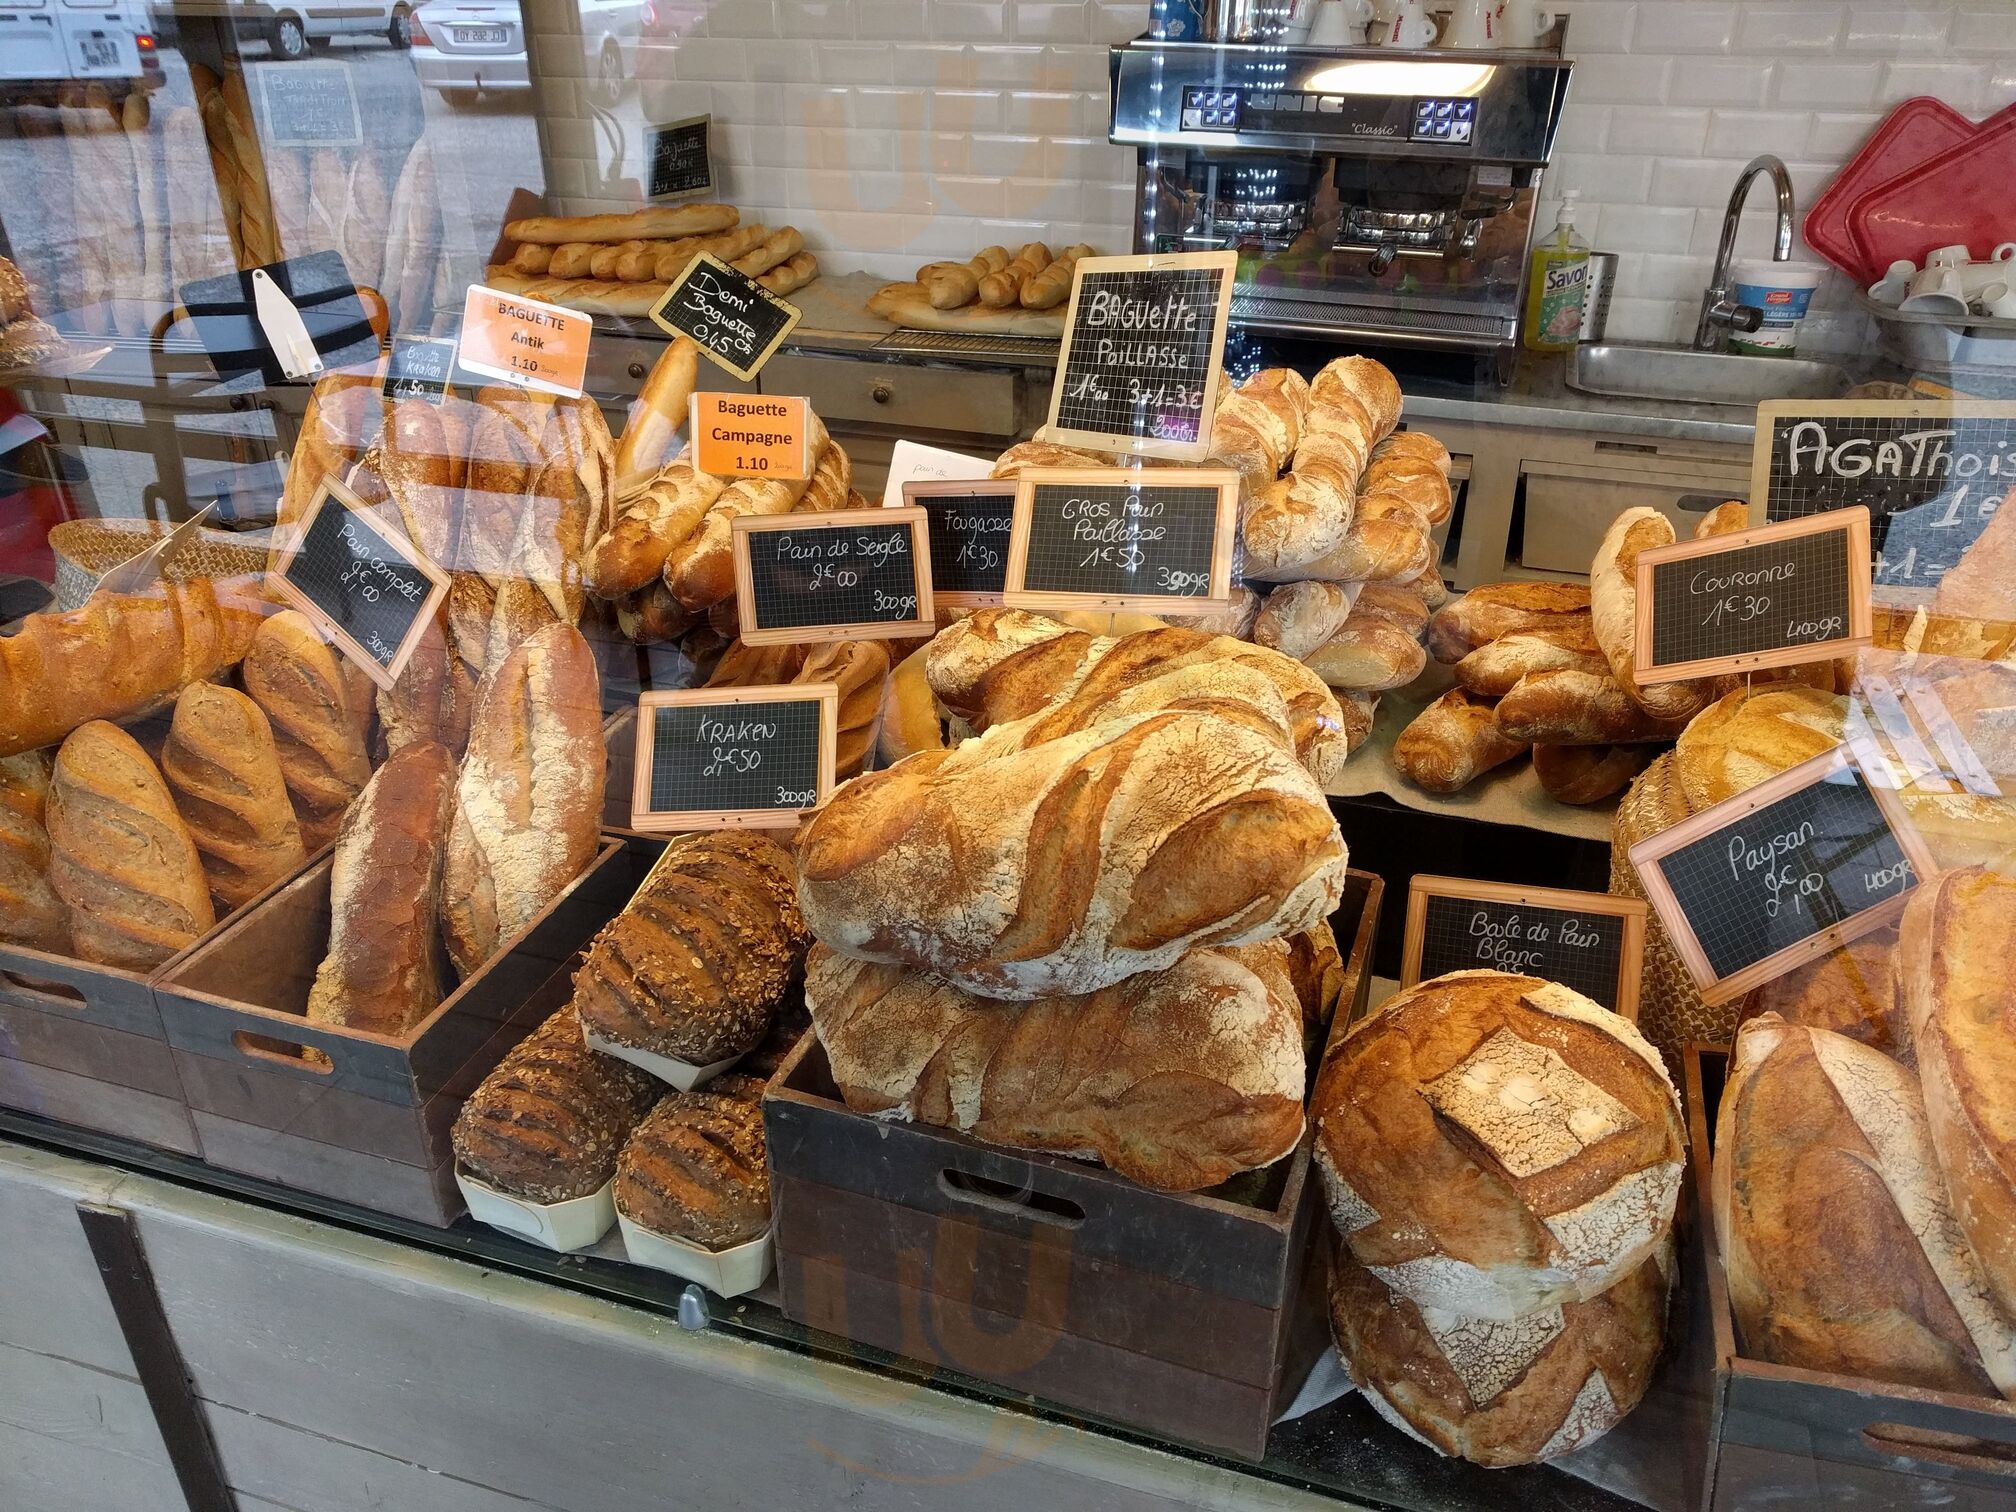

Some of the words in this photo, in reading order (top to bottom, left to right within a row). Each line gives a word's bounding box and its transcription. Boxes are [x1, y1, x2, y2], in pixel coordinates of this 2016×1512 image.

[1249, 93, 1345, 113] UNIC
[1547, 264, 1588, 290] Savon
[688, 272, 754, 313] Demi
[498, 302, 565, 331] BAGUETTE
[683, 293, 756, 343] Baguette
[511, 332, 545, 350] Antik
[511, 355, 538, 372] 1.10
[718, 400, 787, 417] Baguette
[712, 428, 793, 447] Campagne
[736, 457, 768, 471] 1.10
[944, 509, 1012, 545] Fougasse
[1073, 518, 1166, 543] Paillasse
[337, 523, 370, 558] Pain
[370, 557, 422, 602] complet
[777, 536, 822, 561] Pain
[827, 539, 849, 557] de
[856, 532, 908, 568] Seigle
[1728, 821, 1814, 881] Paysan
[1527, 922, 1550, 942] de
[1558, 918, 1600, 948] Pain
[1476, 937, 1544, 967] Blanc
